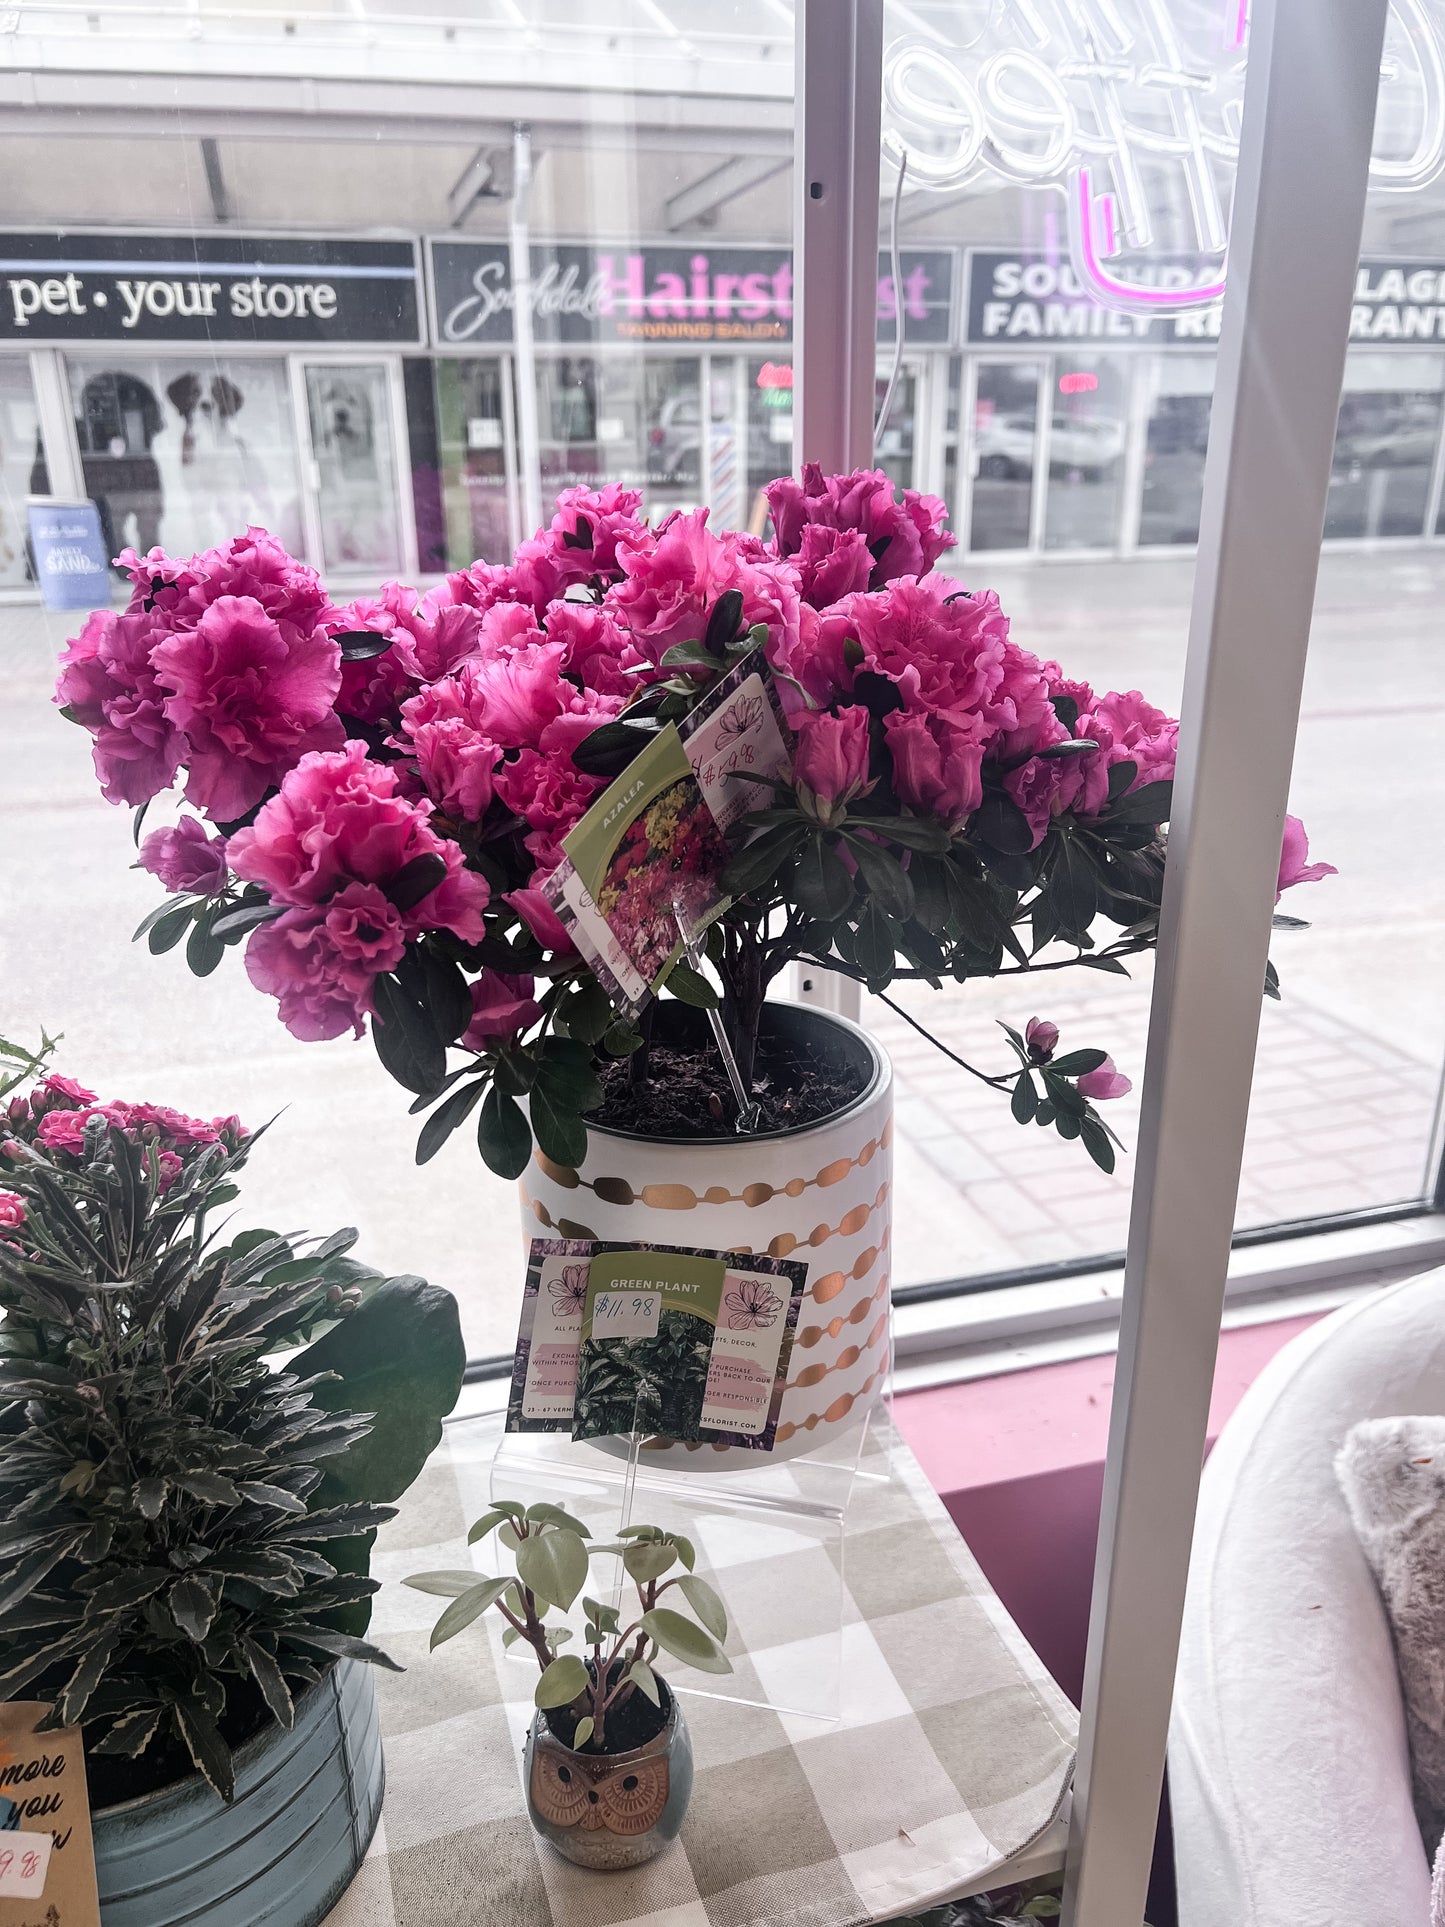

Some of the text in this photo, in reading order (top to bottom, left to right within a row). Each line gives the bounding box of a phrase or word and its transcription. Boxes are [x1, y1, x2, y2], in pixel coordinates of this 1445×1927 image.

[8, 272, 337, 328] pet your store
[616, 322, 787, 340] TANNING SALON
[603, 780, 645, 829] AZALEA
[610, 1279, 700, 1293] GREEN PLANT
[595, 1294, 655, 1319] $11.98
[723, 1371, 741, 1380] BACK
[755, 1377, 771, 1385] OUR
[723, 1392, 768, 1405] RESPONSIBLE
[0, 1754, 66, 1789] more
[2, 1792, 64, 1830] you
